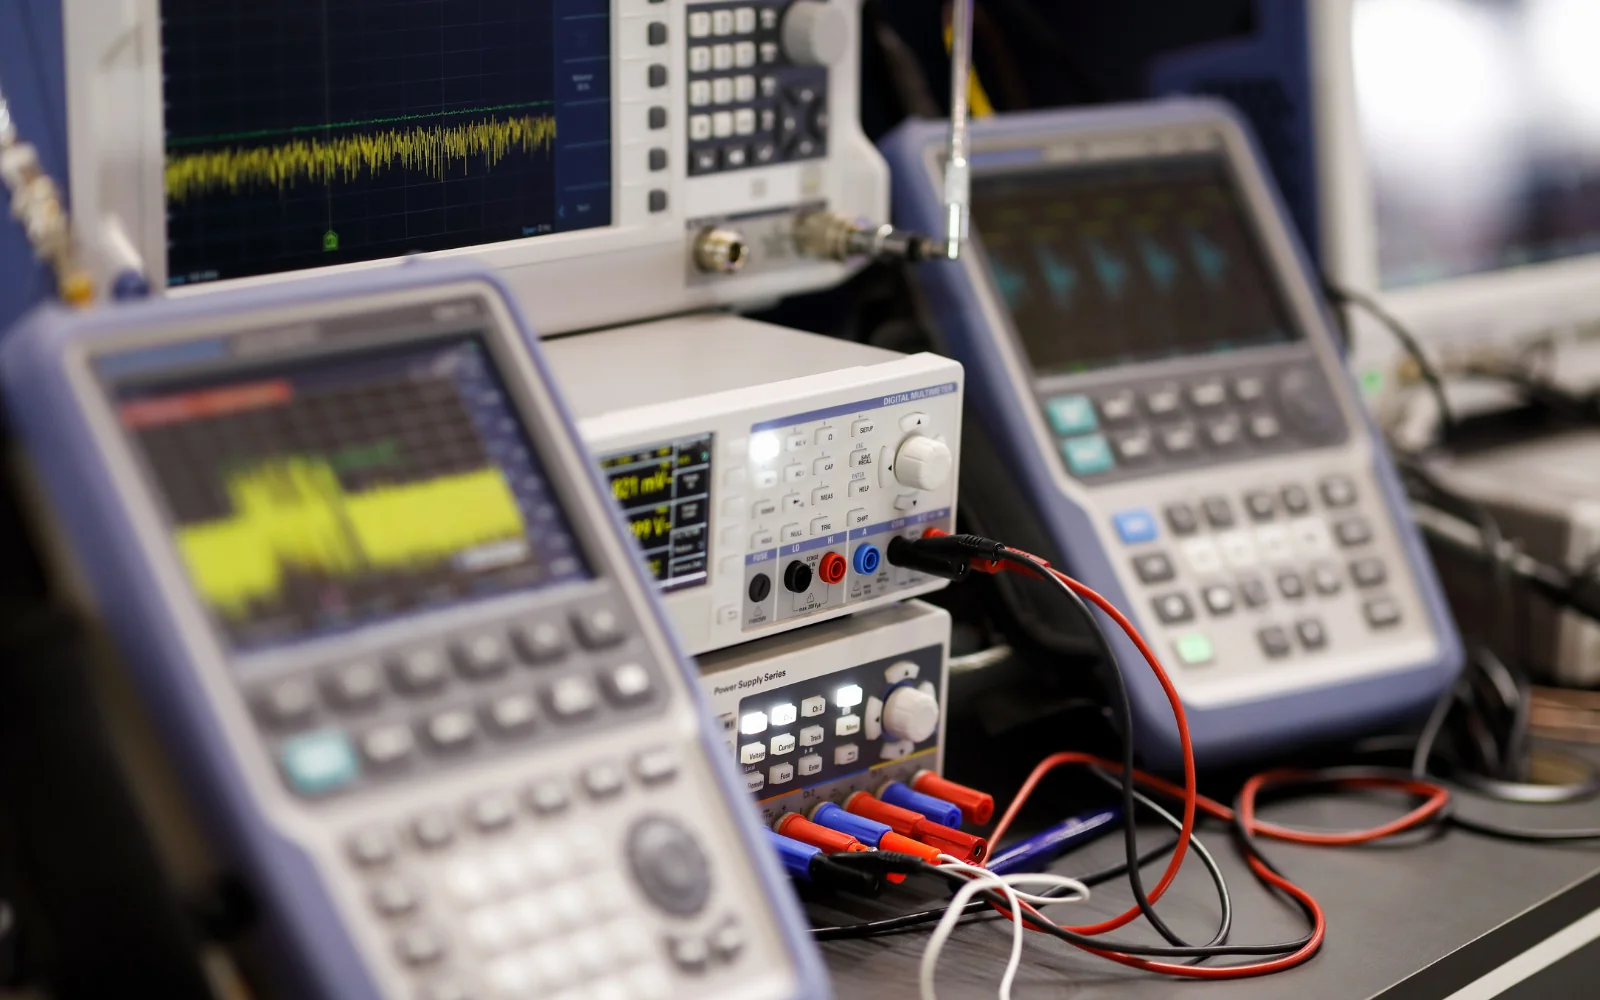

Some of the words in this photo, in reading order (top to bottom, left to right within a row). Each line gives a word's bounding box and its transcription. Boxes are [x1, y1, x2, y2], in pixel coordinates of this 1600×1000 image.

[883, 393, 909, 406] DIGITAL
[910, 382, 953, 400] MULTIMETER
[860, 425, 873, 434] SETUP
[828, 433, 833, 441] Ω
[858, 456, 872, 466] RECALL
[824, 463, 834, 471] CAP
[851, 471, 865, 480] ENTER
[858, 485, 870, 493] HELP
[820, 493, 834, 501] MEAS
[856, 514, 869, 523] SHIFT
[821, 523, 832, 532] TRIG
[862, 527, 868, 536] A
[790, 530, 802, 538] NULL
[827, 535, 834, 545] HI
[792, 543, 800, 553] LO
[752, 551, 769, 562] FUSE
[713, 684, 737, 696] Power
[738, 675, 764, 690] Supply
[764, 669, 787, 682] Series
[810, 734, 822, 743] Track
[778, 741, 795, 752] Current
[749, 752, 765, 761] Voltage
[745, 763, 756, 772] Local
[808, 763, 820, 772] Enter
[780, 772, 791, 781] Fuse
